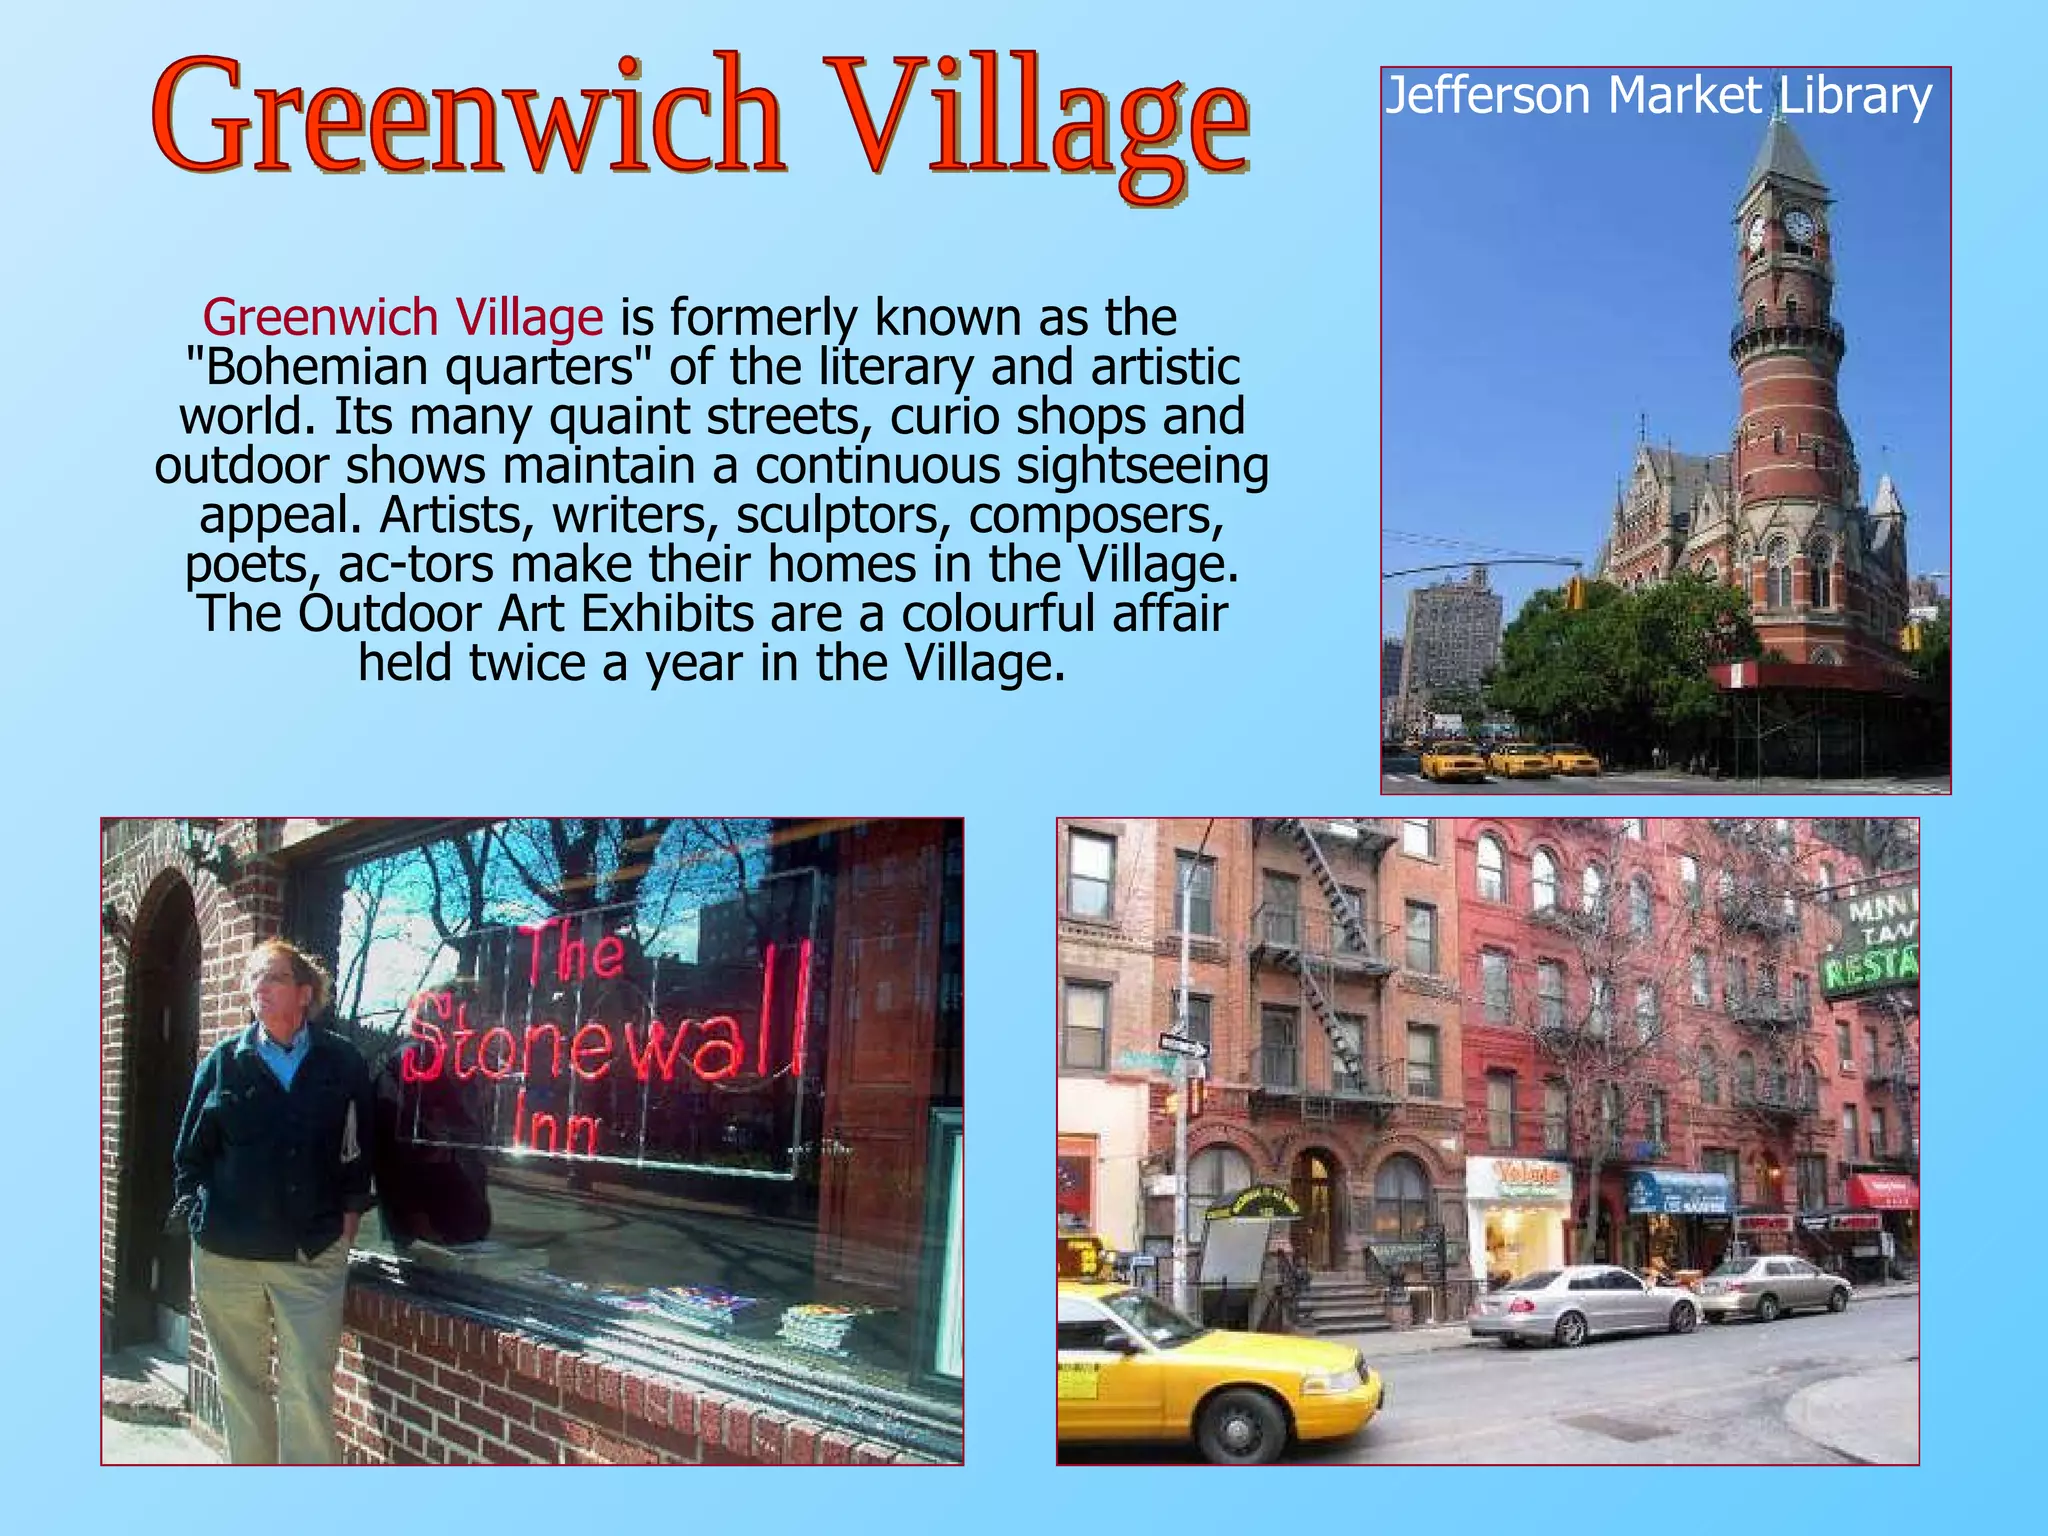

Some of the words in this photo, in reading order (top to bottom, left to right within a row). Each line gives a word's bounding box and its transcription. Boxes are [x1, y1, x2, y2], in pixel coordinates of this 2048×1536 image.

[517, 917, 625, 987] The
[402, 938, 811, 1083] Stonewall
[513, 1087, 602, 1159] Inn
